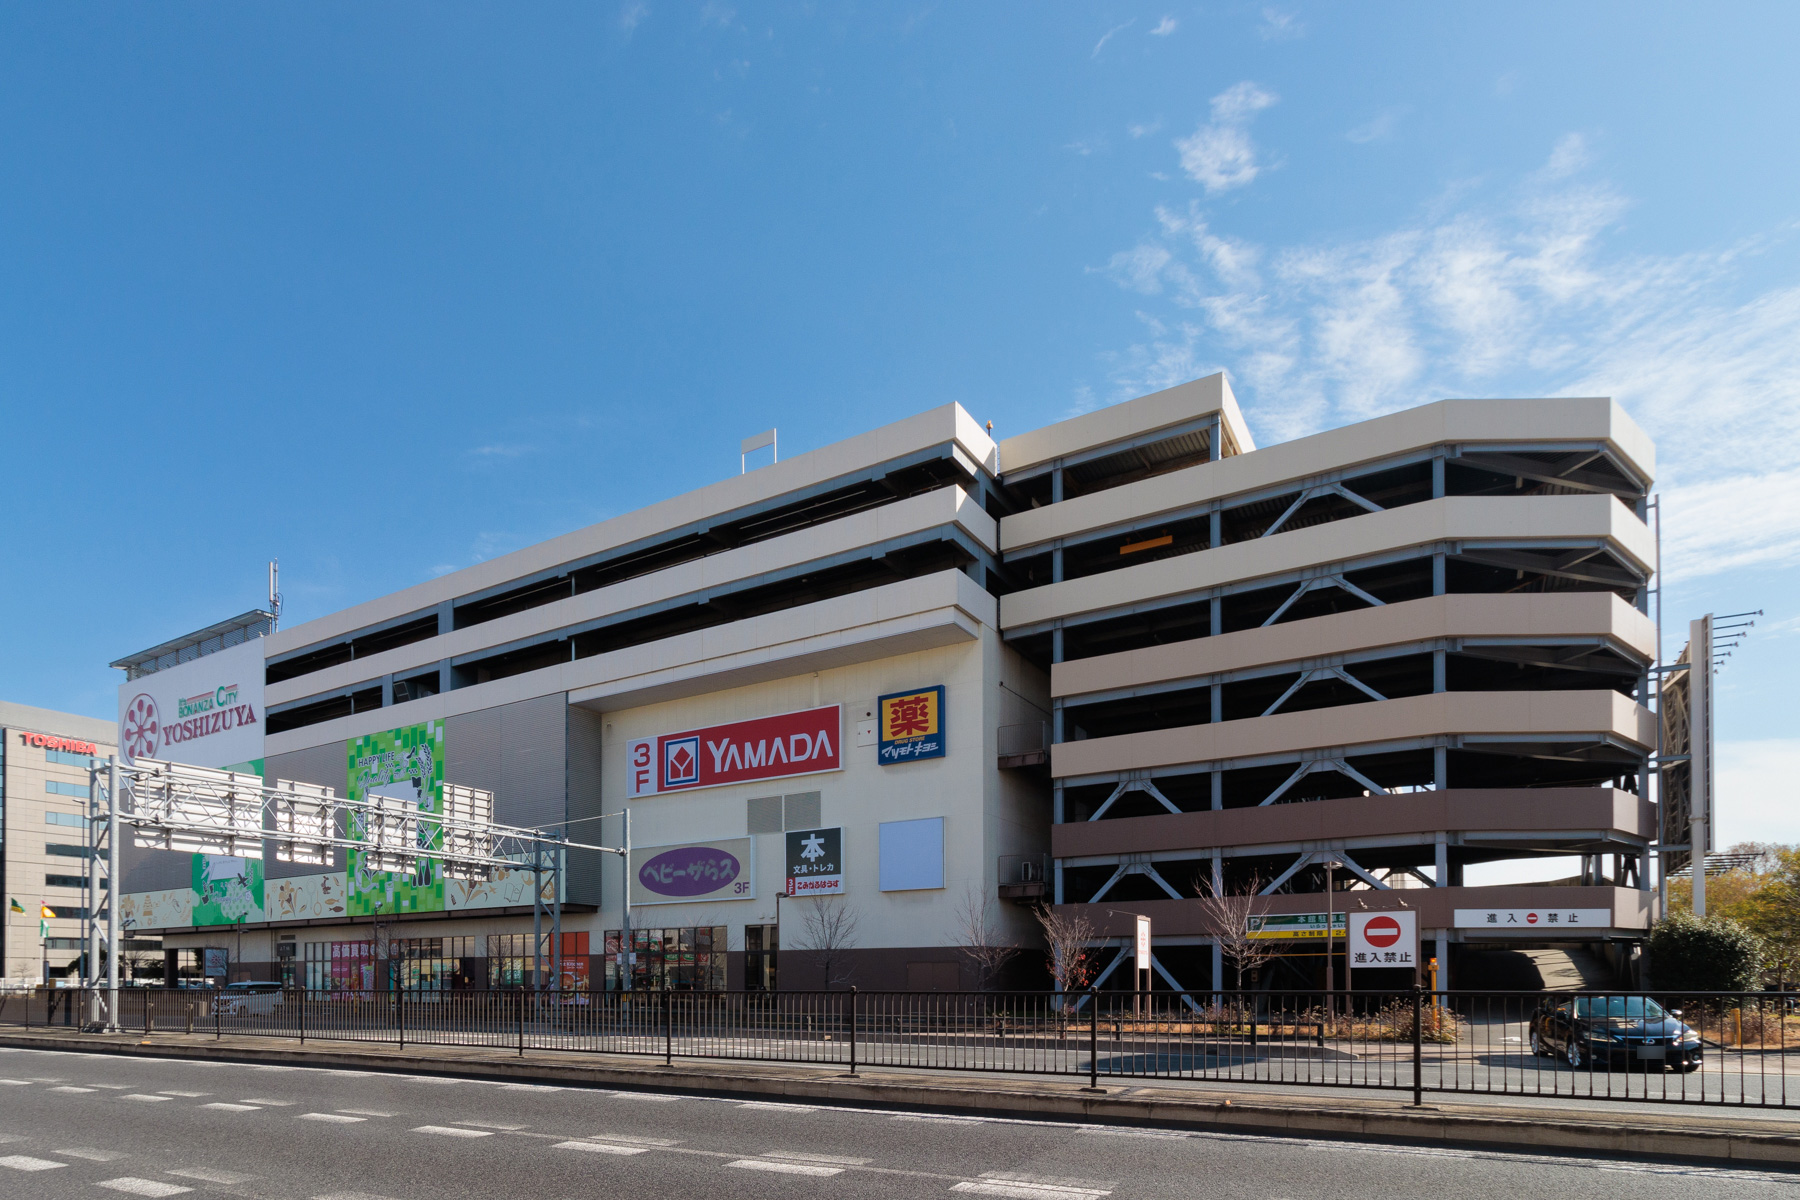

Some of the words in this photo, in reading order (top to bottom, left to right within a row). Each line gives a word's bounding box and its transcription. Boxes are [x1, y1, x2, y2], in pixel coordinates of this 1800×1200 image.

[178, 698, 214, 718] BONANZA
[890, 696, 930, 737] 薬
[163, 704, 257, 746] YOSHIZUYA
[21, 732, 98, 755] TOSHIBA
[706, 730, 834, 773] YAMADA
[881, 741, 939, 759] マツモトキヨシ
[358, 754, 381, 768] HAPPY
[381, 751, 395, 763] LIFE
[633, 742, 651, 794] 3F
[800, 833, 826, 862] 本
[643, 858, 735, 884] ベビーザらス
[793, 863, 834, 874] 文具・トレカ
[733, 881, 750, 894] 3F
[1486, 913, 1518, 924] 進入
[1547, 913, 1579, 924] 禁止
[332, 943, 369, 958] 高価買取
[1354, 951, 1412, 964] 進入禁止
